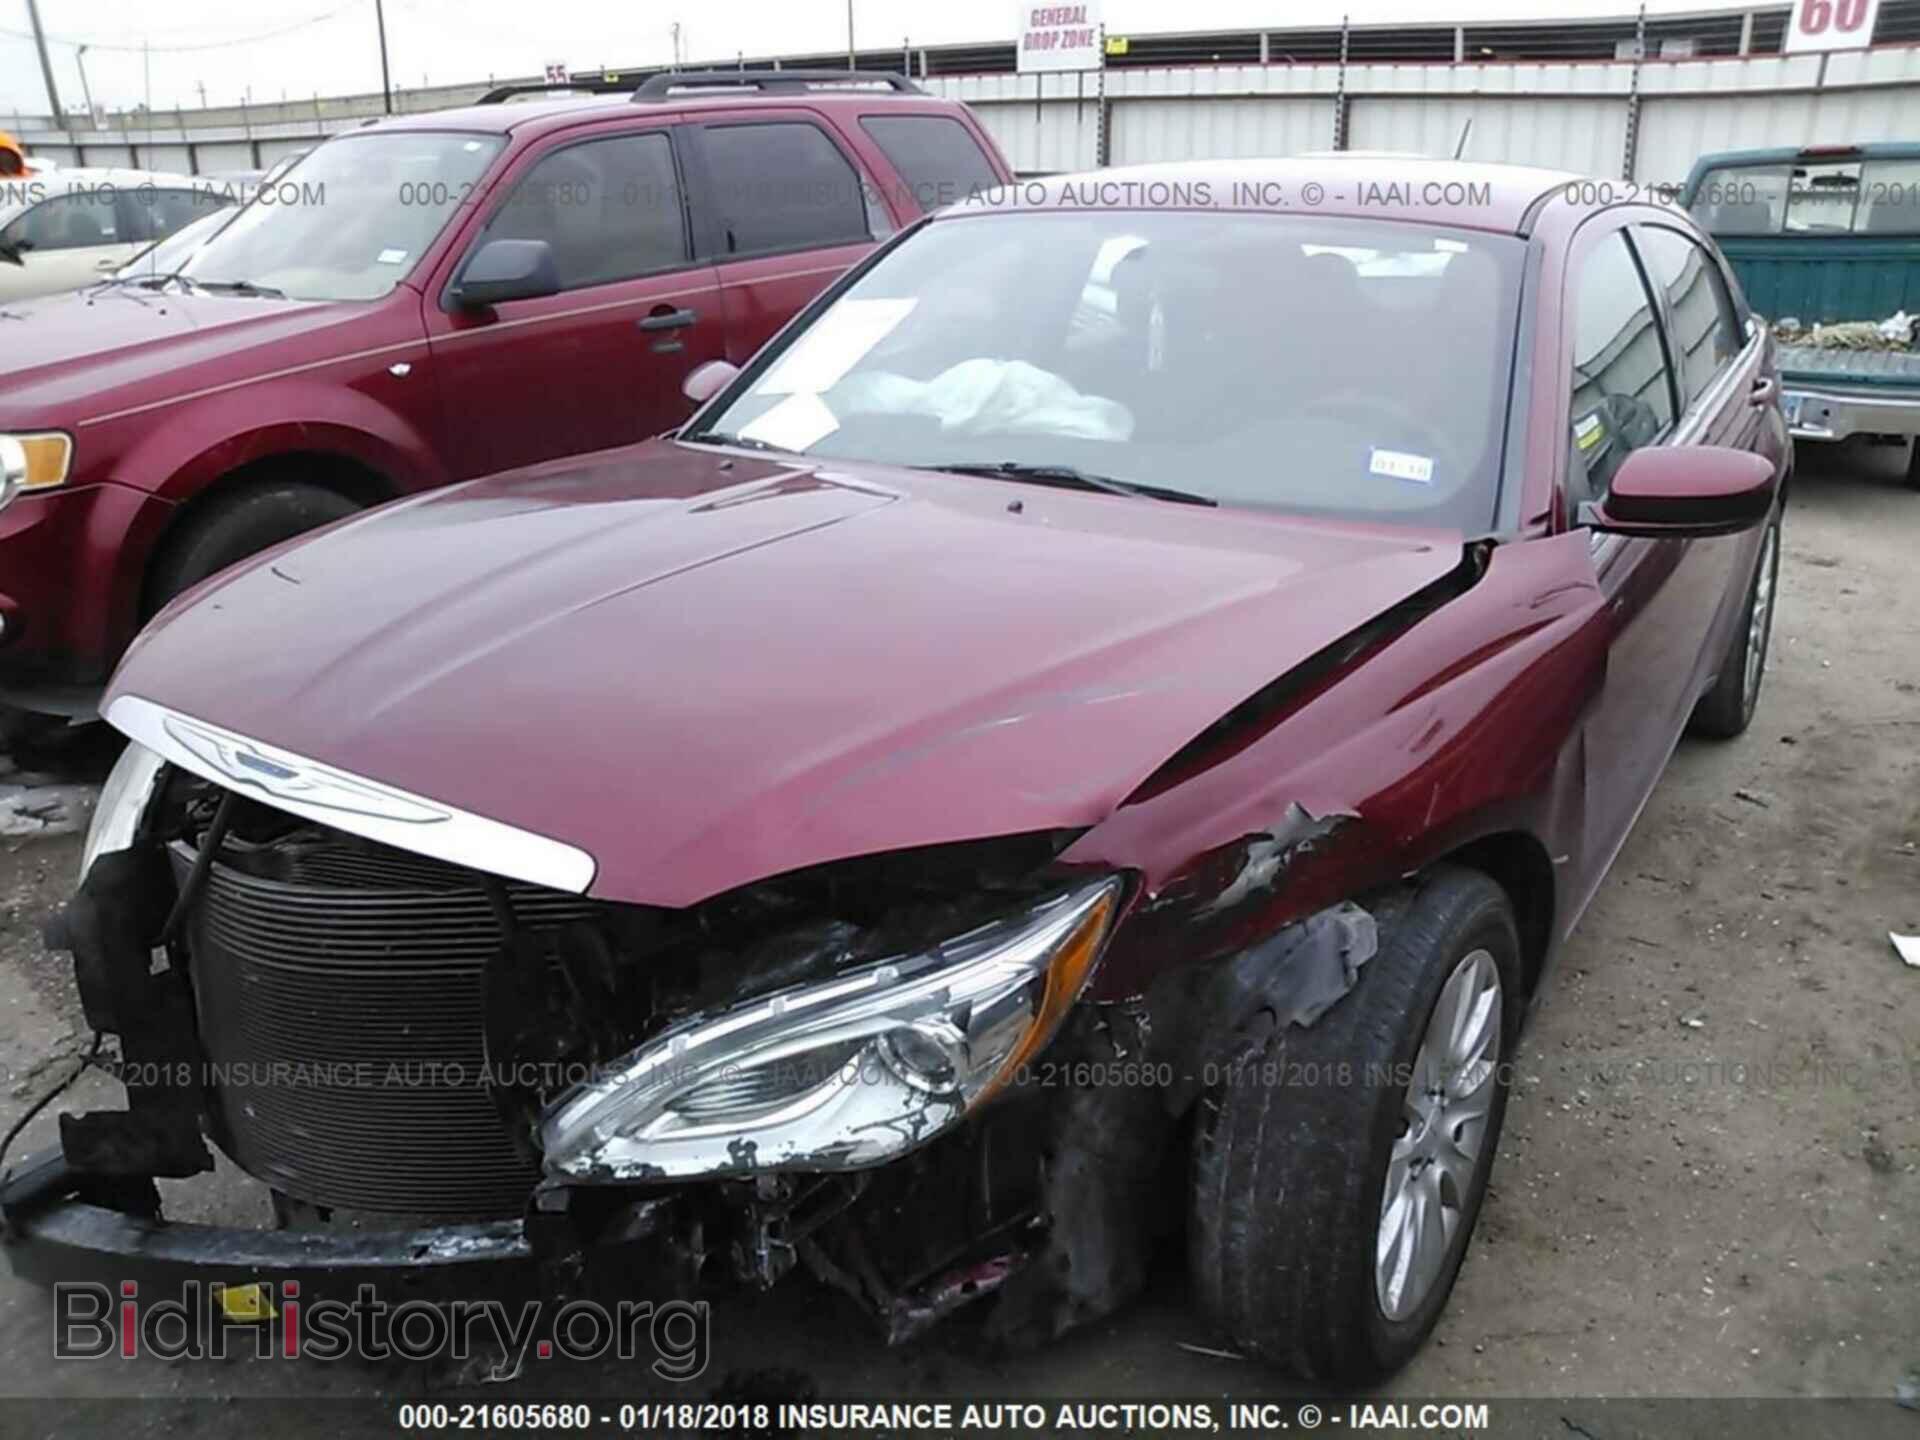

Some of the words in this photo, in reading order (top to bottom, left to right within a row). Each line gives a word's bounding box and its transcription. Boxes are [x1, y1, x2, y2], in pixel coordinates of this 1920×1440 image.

[1030, 6, 1087, 27] GENERAL
[1023, 31, 1059, 50] DROP
[1060, 29, 1095, 49] ZONE
